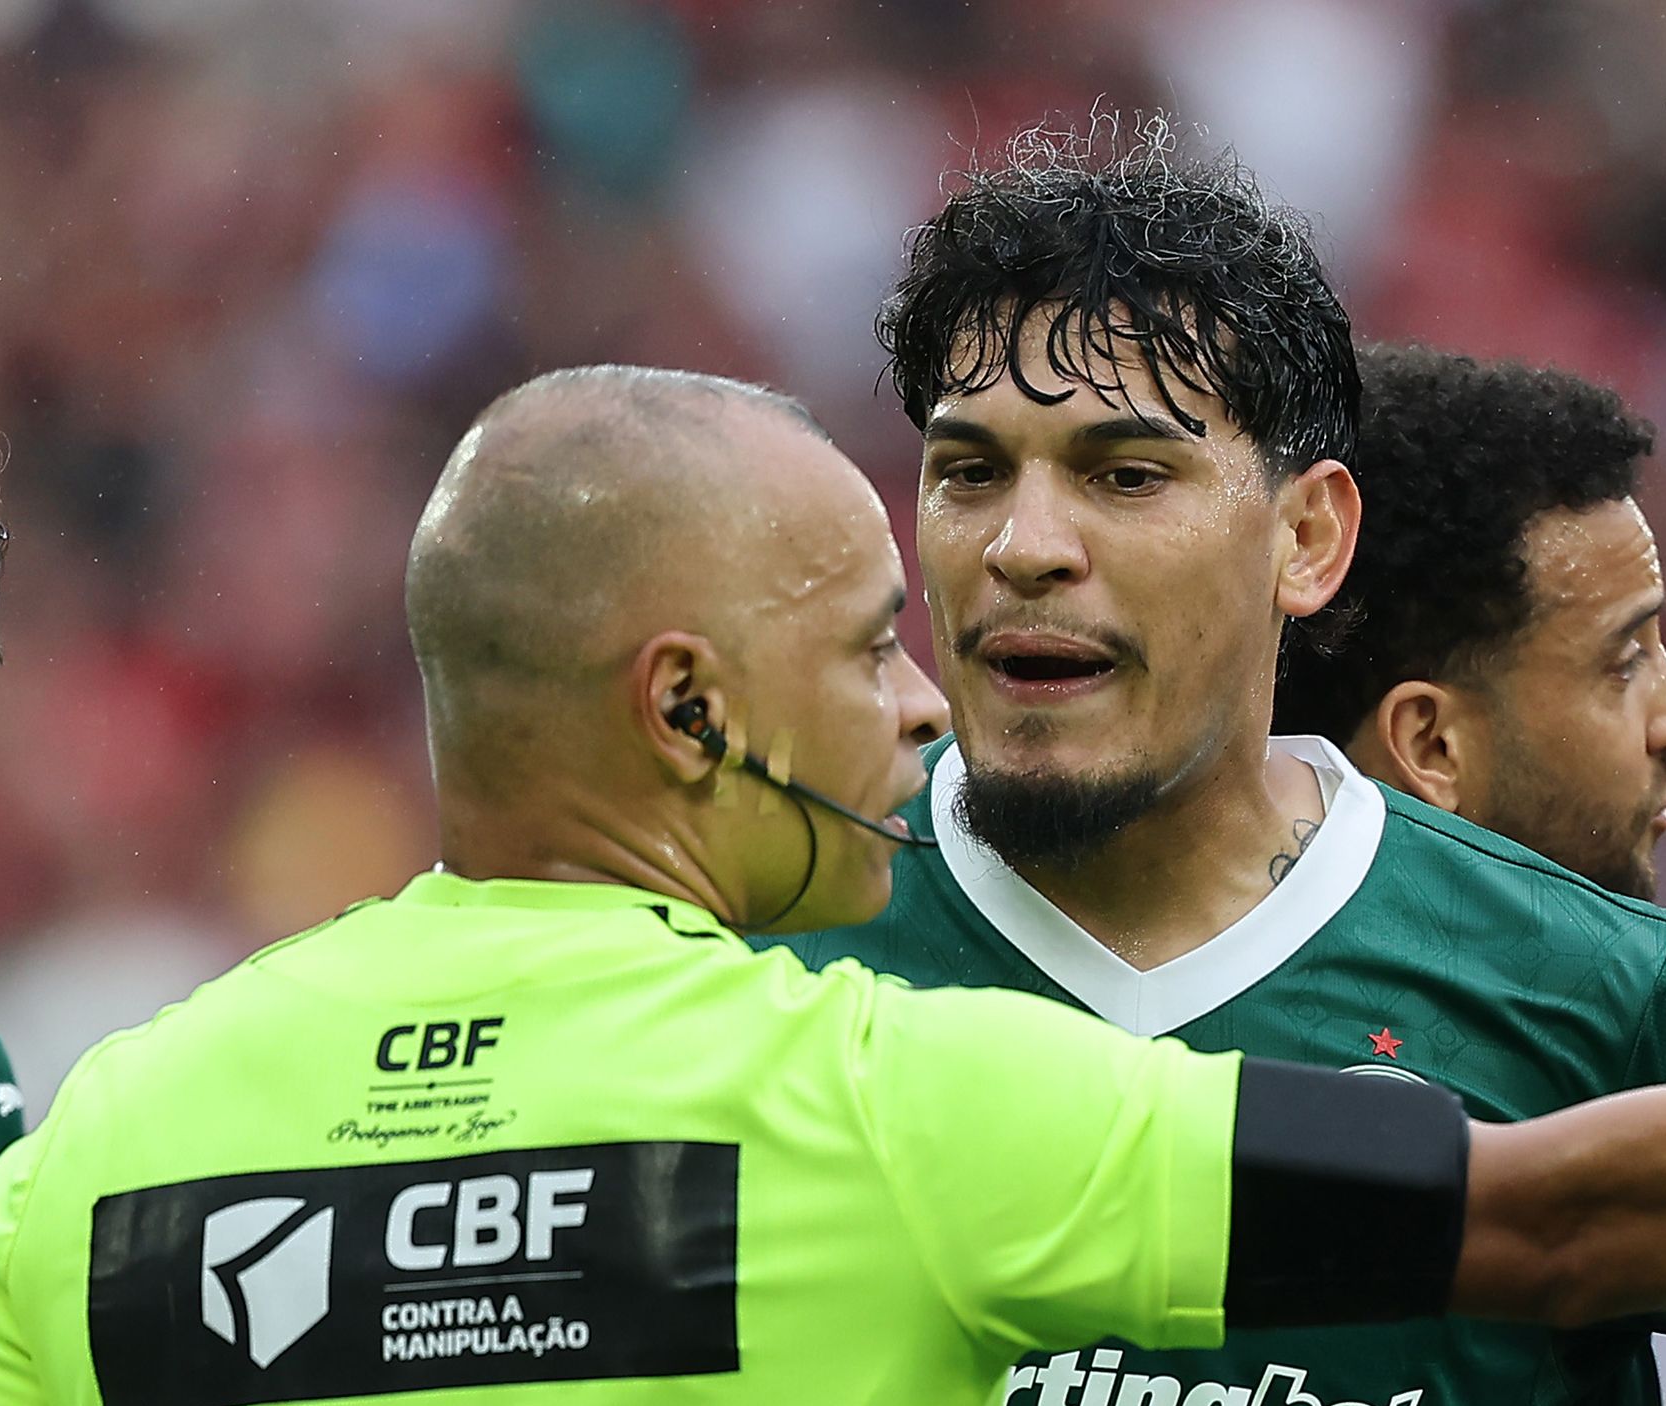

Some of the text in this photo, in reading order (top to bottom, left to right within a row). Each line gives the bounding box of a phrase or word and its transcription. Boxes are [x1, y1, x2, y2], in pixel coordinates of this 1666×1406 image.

[376, 1017, 505, 1072] CBF
[384, 1168, 595, 1271] CBF
[382, 1295, 523, 1331] CONTRA A
[382, 1317, 590, 1362] MANIPULAÇÃO
